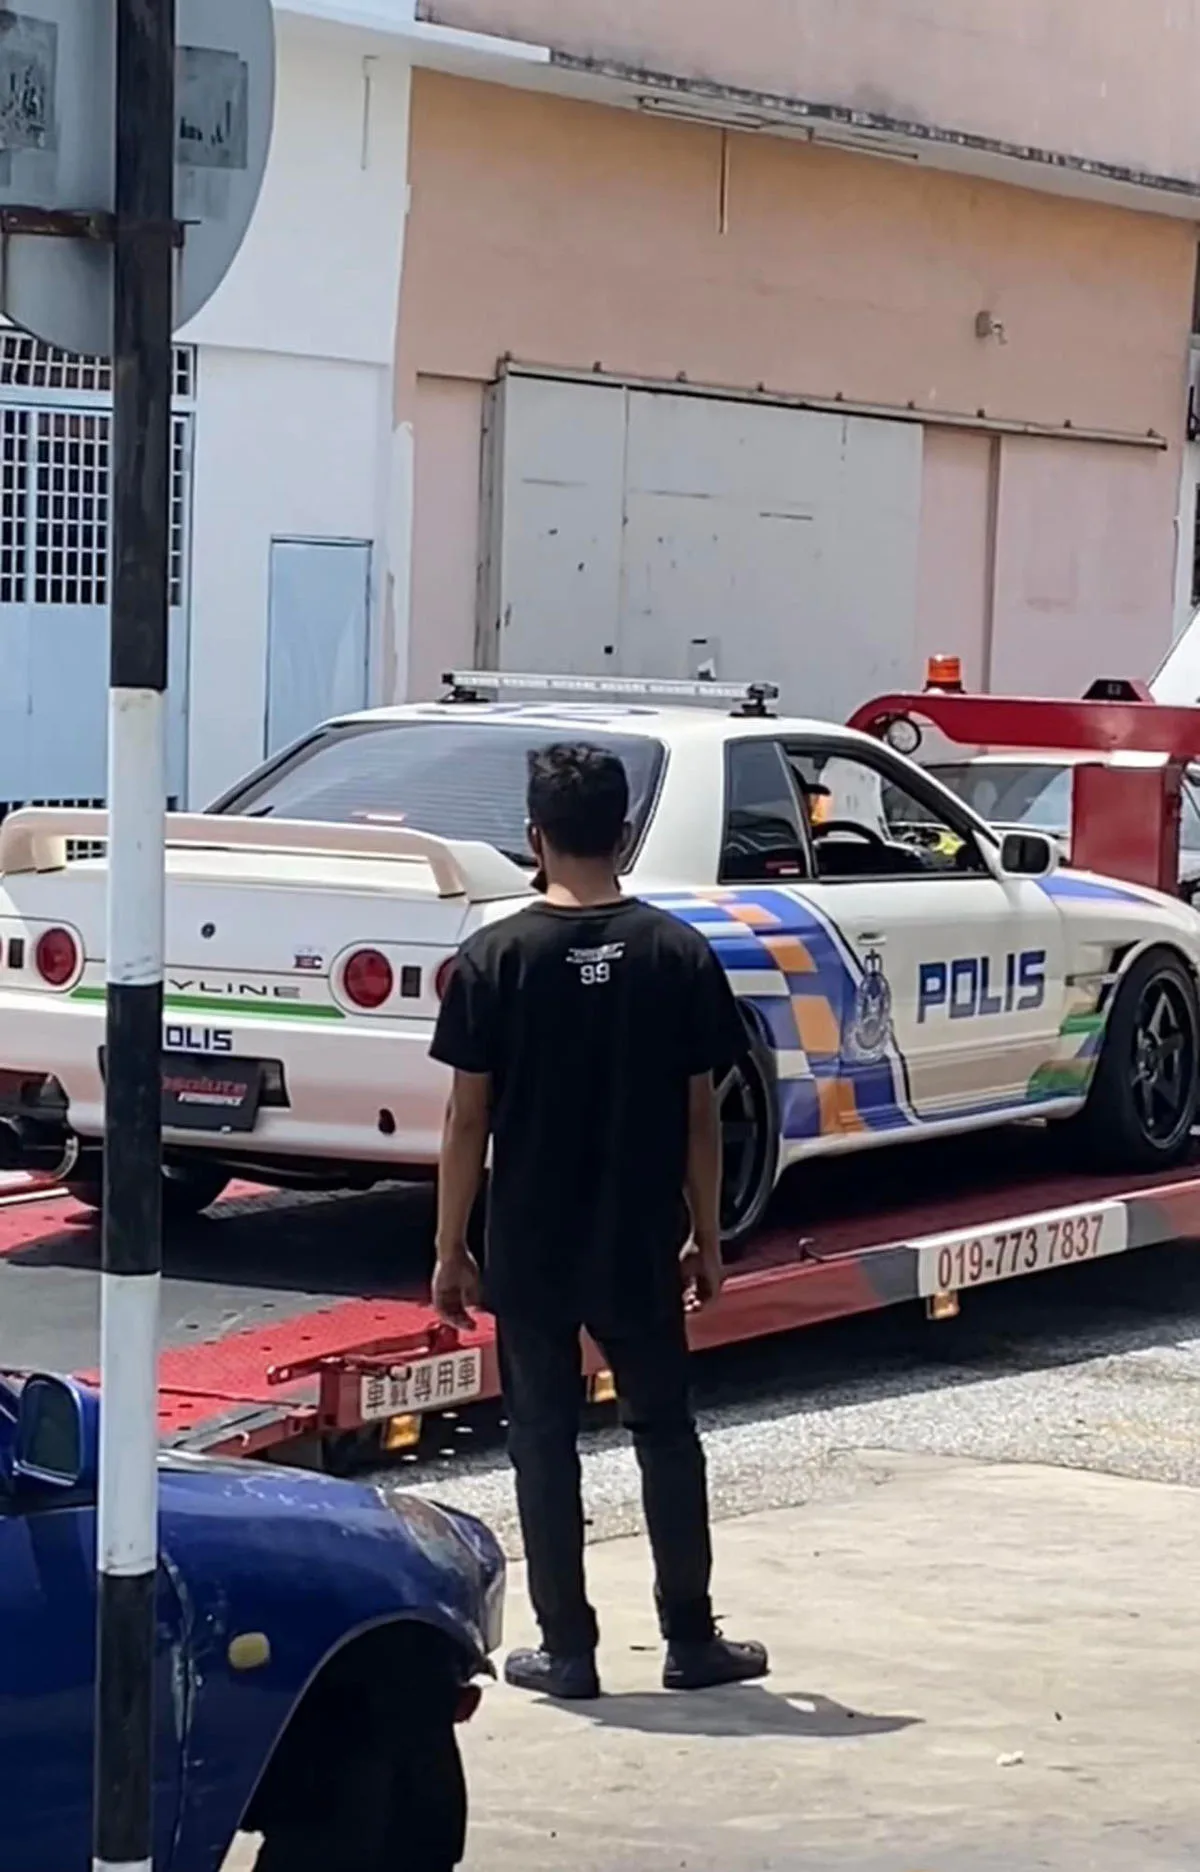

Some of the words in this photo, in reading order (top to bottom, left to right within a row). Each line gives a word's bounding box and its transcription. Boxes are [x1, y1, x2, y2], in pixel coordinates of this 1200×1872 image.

[580, 962, 610, 984] 99
[917, 949, 1046, 1023] POLIS
[167, 979, 301, 998] YLINE
[166, 1025, 232, 1051] OLIS
[938, 1228, 1038, 1288] 019-773
[1047, 1215, 1103, 1263] 7837
